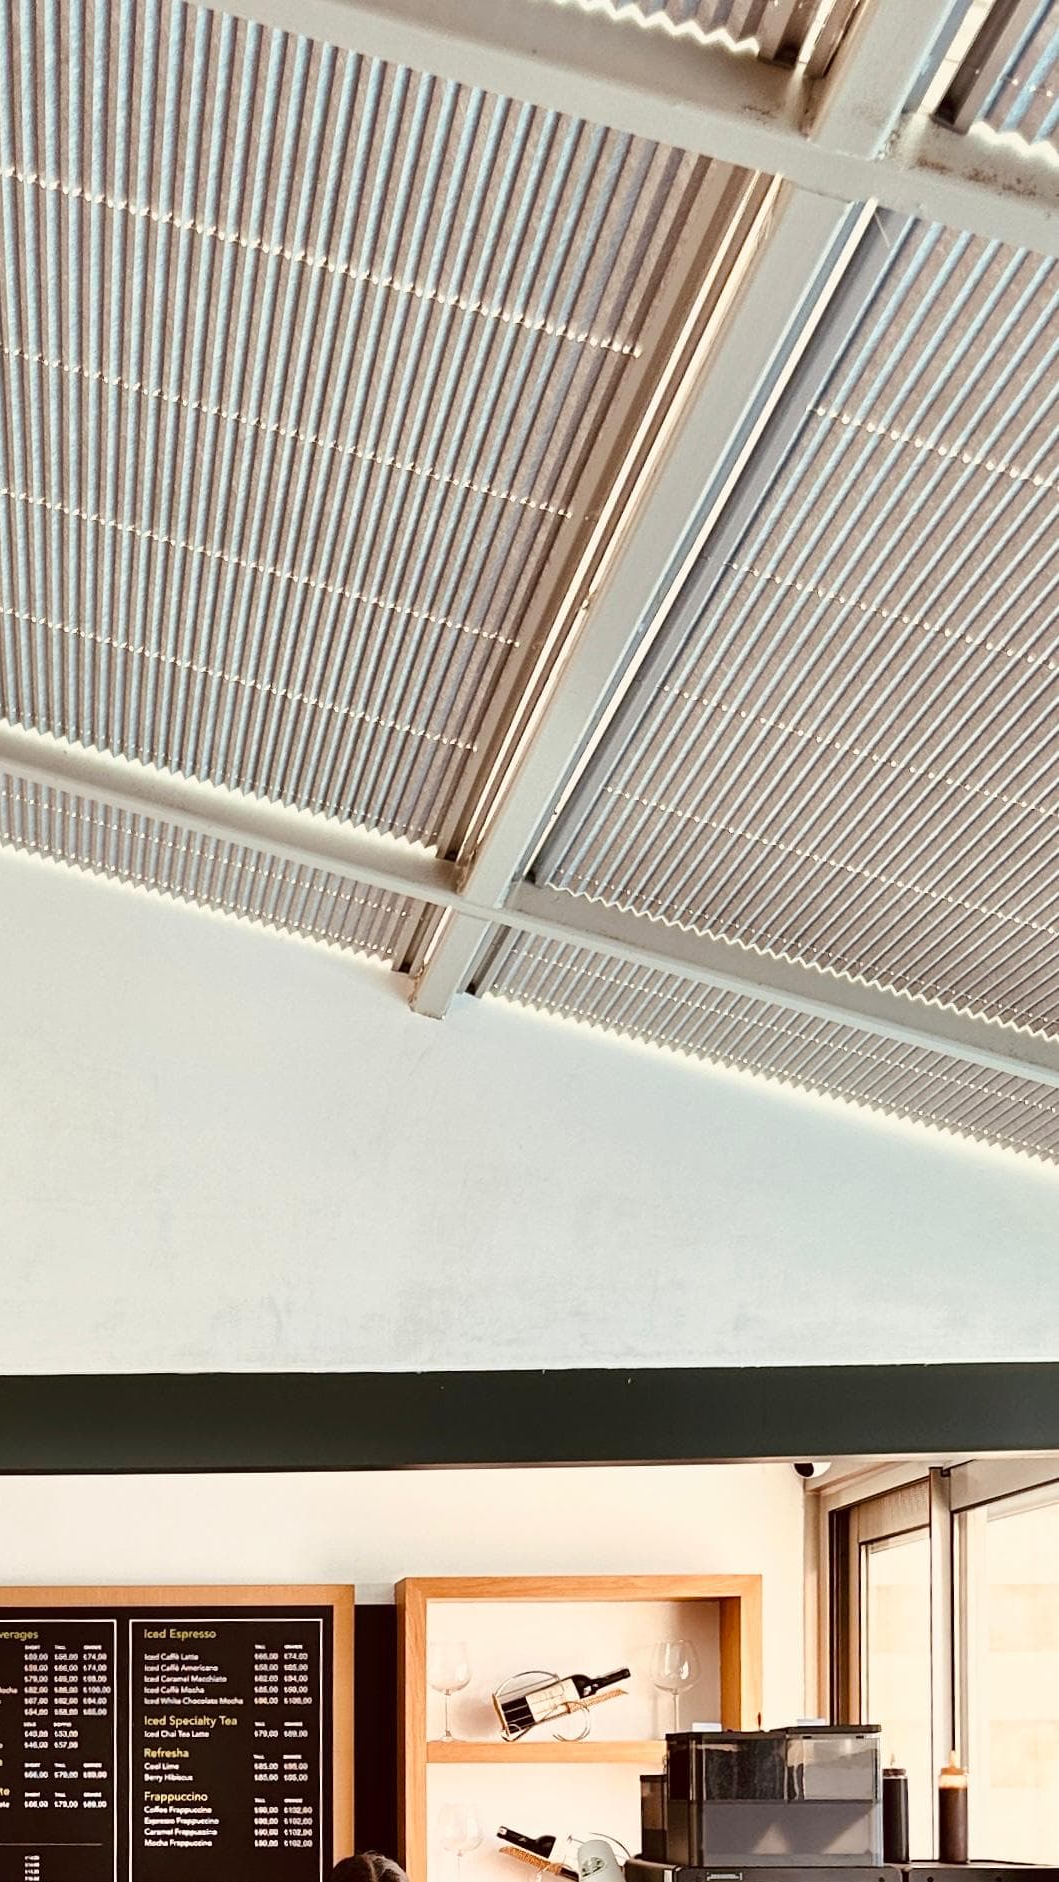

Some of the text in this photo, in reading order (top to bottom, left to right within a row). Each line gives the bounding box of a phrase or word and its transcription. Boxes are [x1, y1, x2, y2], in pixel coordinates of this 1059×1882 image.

[144, 1629, 216, 1641] Iced Espresso
[144, 1715, 237, 1728] Iced Specialty Tea
[144, 1747, 189, 1758] Refresha
[145, 1791, 208, 1804] Frappuccino
